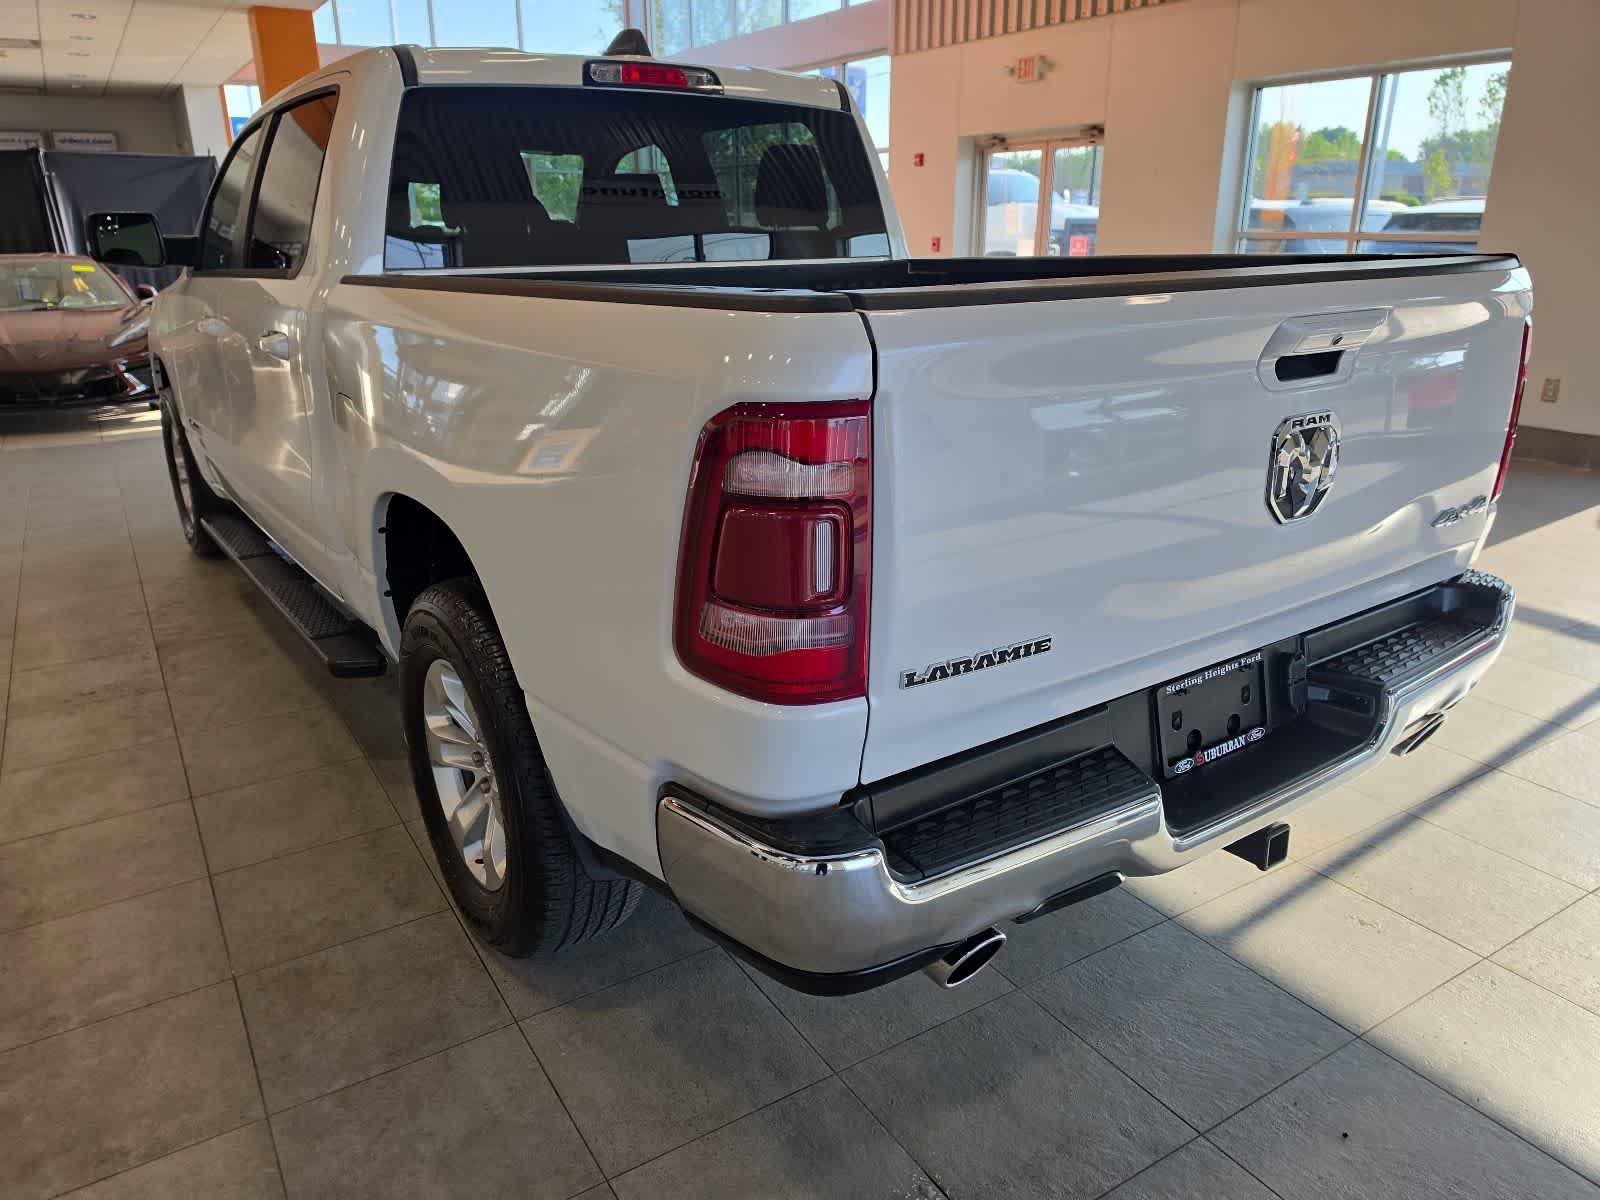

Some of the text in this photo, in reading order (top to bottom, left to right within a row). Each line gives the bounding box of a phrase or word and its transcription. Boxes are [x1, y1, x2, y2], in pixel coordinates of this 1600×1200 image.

[1291, 413, 1332, 429] RAM
[899, 634, 1054, 689] LARAMIE
[1165, 652, 1263, 695] Sterling Heights Ford
[1195, 734, 1246, 766] SUBURBAN
